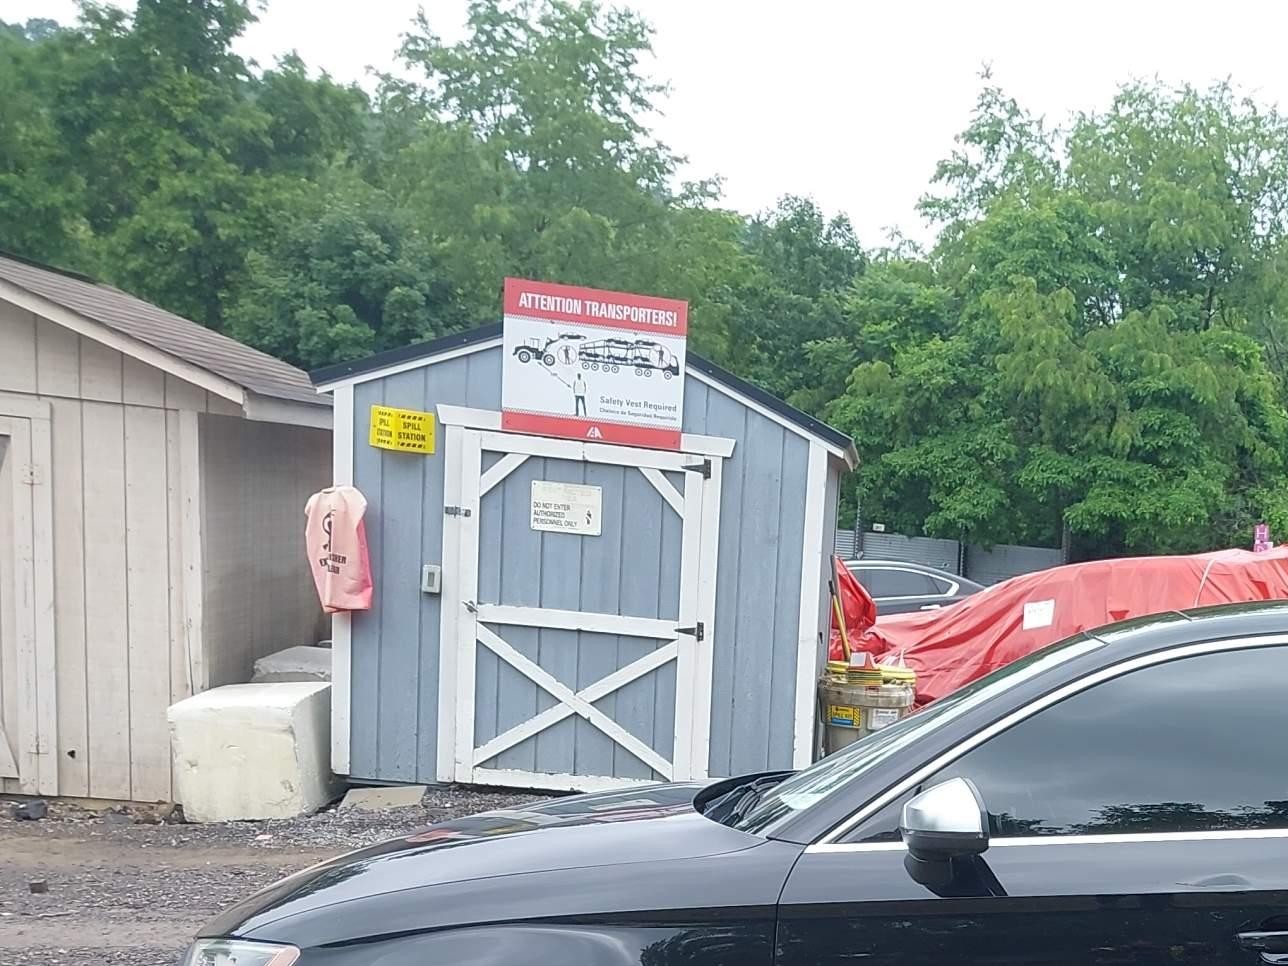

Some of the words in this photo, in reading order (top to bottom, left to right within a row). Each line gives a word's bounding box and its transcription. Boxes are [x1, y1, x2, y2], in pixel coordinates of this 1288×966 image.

[519, 292, 581, 315] ATTENTION
[585, 300, 677, 327] TRANSPORTERS!
[600, 396, 624, 407] Safety
[626, 400, 641, 408] Vest
[644, 401, 676, 412] Required
[403, 422, 421, 431] SPILL
[398, 431, 425, 441] STATION
[554, 503, 570, 511] ENTER
